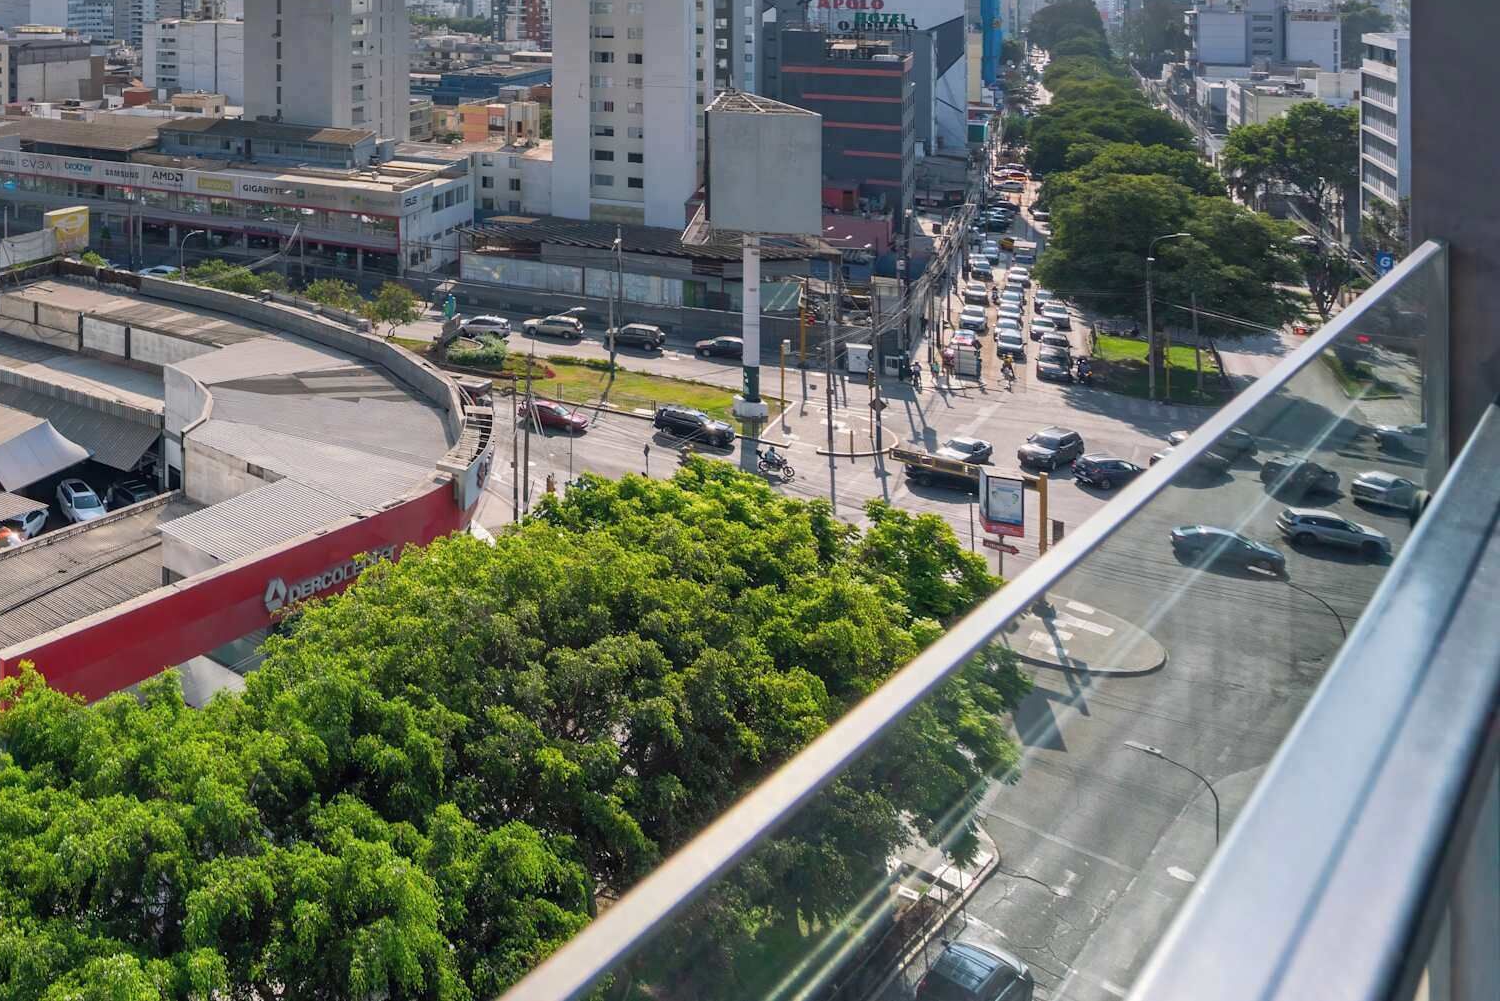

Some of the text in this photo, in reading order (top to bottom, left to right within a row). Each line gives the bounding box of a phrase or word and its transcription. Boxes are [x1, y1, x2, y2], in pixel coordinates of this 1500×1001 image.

[854, 12, 907, 24] HOTEL
[65, 161, 93, 172] brother
[105, 168, 140, 179] SAMSUNG
[152, 171, 177, 181] AMD
[242, 184, 285, 195] GIGABYTE
